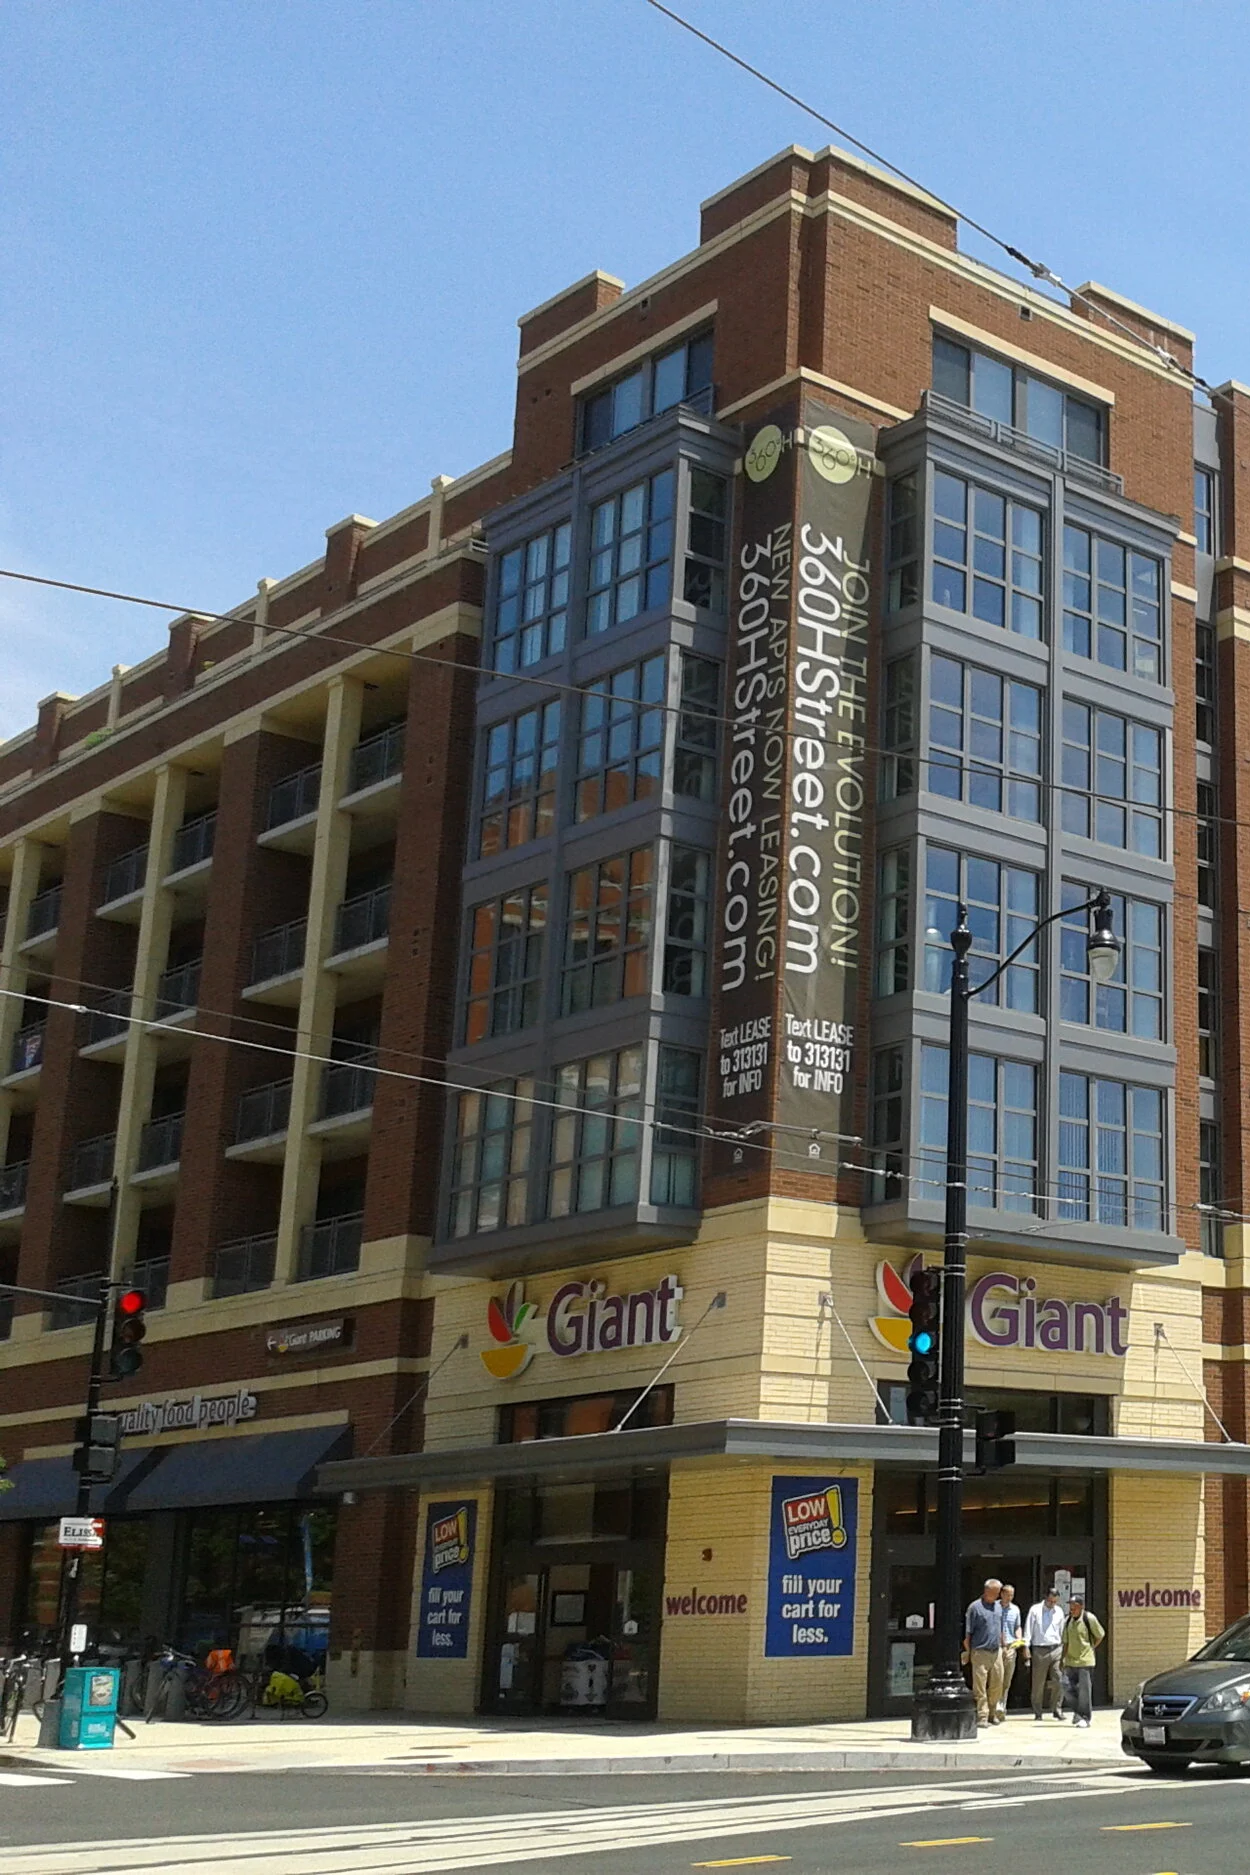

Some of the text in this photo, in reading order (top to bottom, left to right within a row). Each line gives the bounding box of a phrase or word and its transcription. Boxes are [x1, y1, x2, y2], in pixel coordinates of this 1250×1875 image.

[721, 532, 773, 992] 360HStreet.com
[753, 522, 792, 982] NEW APTS NOW LEASING!
[784, 522, 844, 975] 360HStreet.com
[830, 550, 871, 970] JOIN THE EVOLUTION!
[719, 1015, 772, 1050] Text LEASE
[784, 1012, 855, 1047] Text LEASE
[719, 1041, 769, 1076] to 313131
[786, 1039, 851, 1073] to 313131
[722, 1068, 763, 1099] for INFO
[792, 1065, 844, 1095] for INFO
[546, 1273, 684, 1358] Giant
[969, 1271, 1131, 1358] Giant
[117, 1388, 257, 1434] uality food people
[787, 1497, 827, 1524] LOW
[433, 1519, 459, 1543] LOW
[787, 1517, 830, 1537] EVERYDAY
[788, 1526, 832, 1556] price
[427, 1587, 465, 1607] fill your
[665, 1586, 749, 1617] welcome
[782, 1574, 843, 1598] fill your
[1117, 1581, 1202, 1608] welcome
[427, 1608, 463, 1625] cart for
[781, 1599, 841, 1619] cart for
[431, 1628, 454, 1647] less.
[792, 1623, 829, 1644] less.
